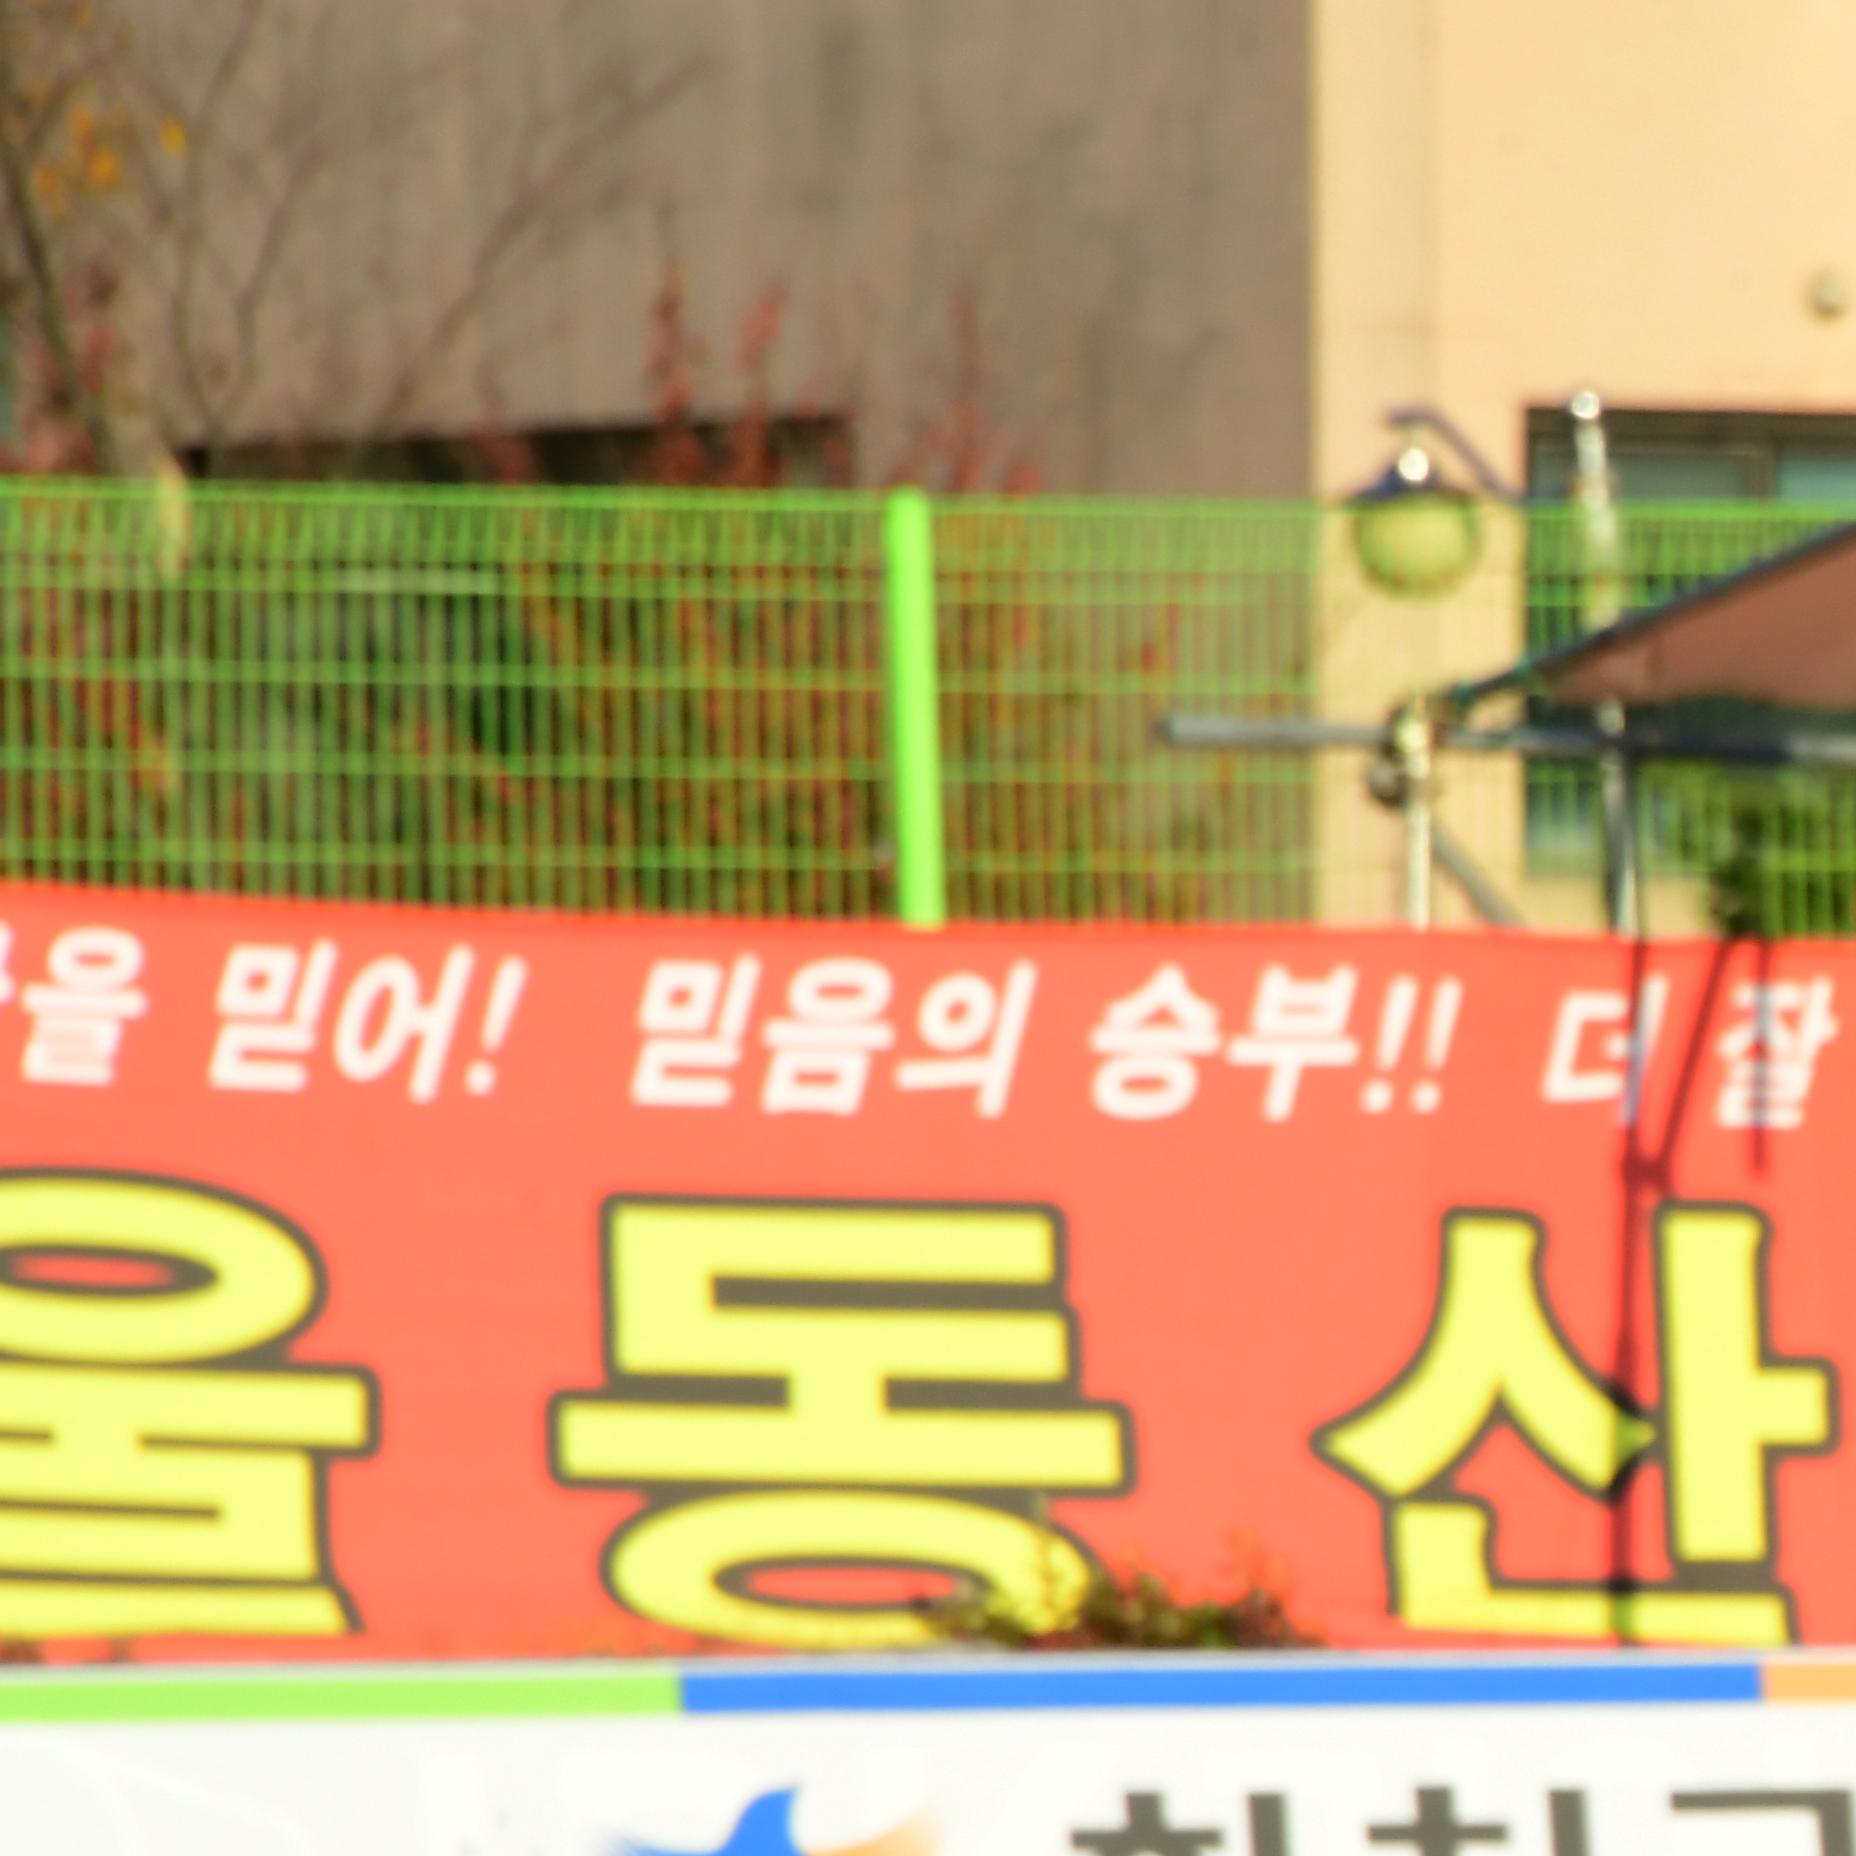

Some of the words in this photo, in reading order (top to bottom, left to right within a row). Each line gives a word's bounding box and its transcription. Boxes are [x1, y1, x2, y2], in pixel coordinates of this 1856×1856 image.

[0, 921, 148, 1086] 을
[207, 938, 528, 1105] 믿어!
[630, 953, 1039, 1119] 믿음의
[1087, 962, 1464, 1123] 승부!!
[1540, 973, 1671, 1128] 더
[1713, 975, 1838, 1130] 잘
